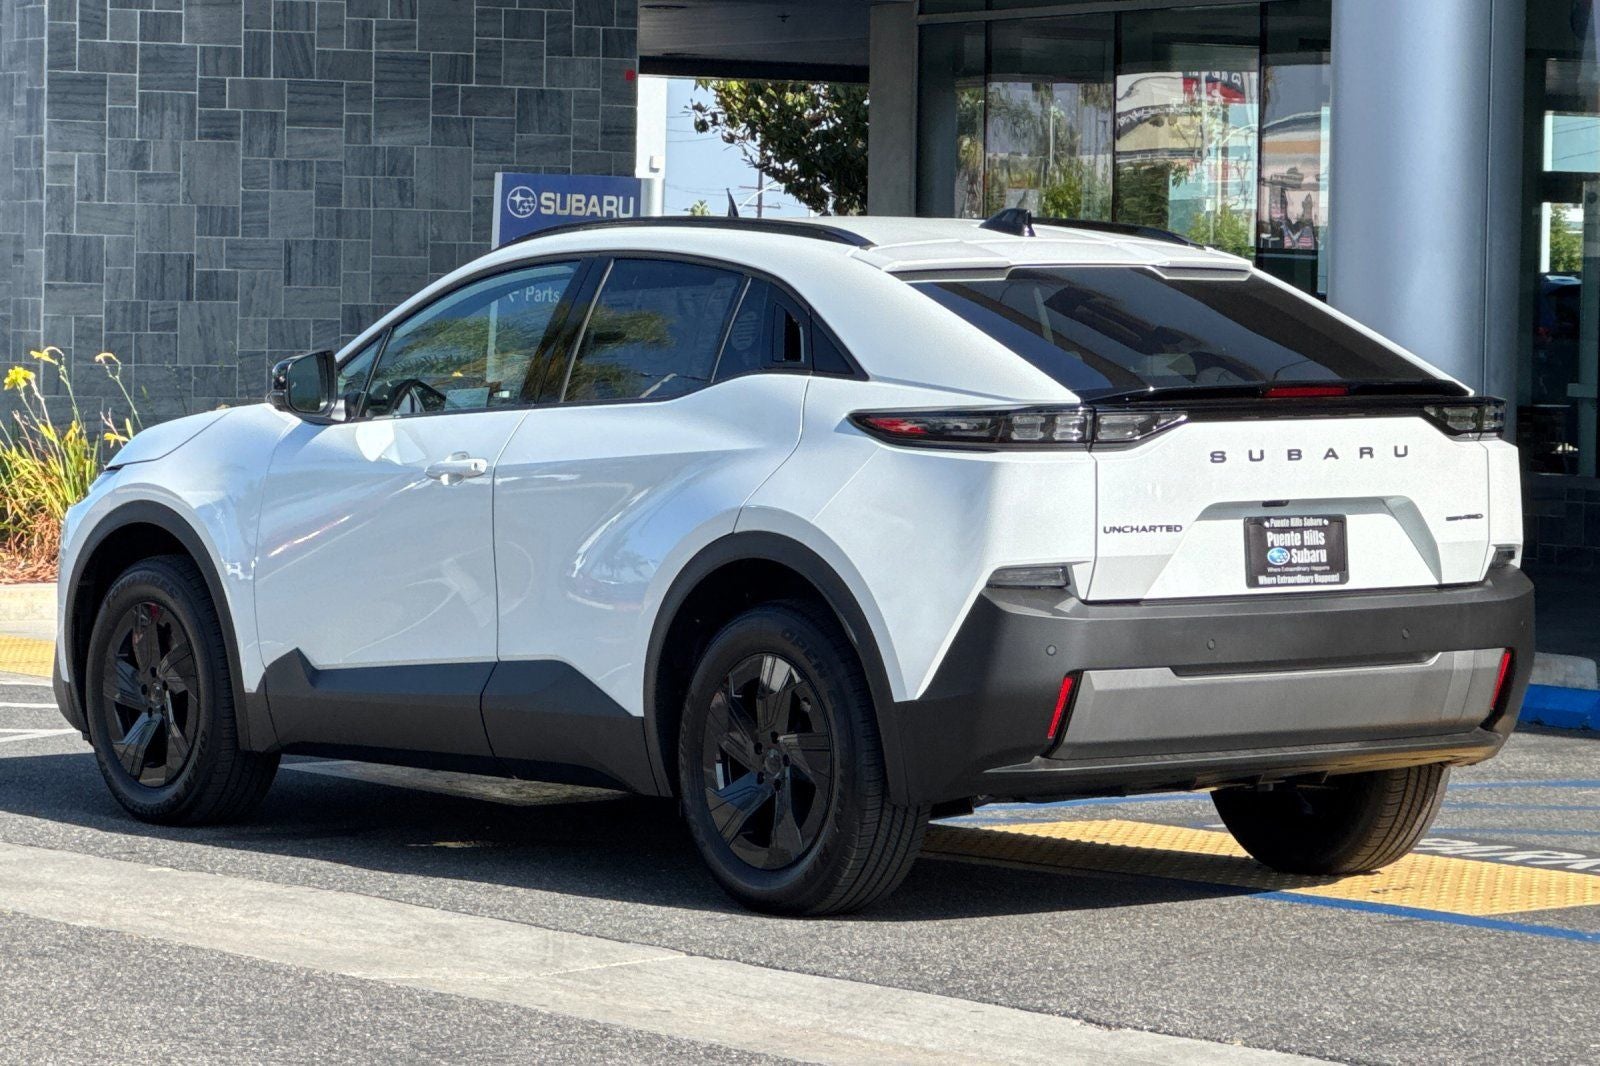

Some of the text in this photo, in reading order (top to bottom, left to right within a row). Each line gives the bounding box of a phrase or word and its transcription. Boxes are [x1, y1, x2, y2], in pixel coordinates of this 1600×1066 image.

[540, 191, 634, 218] SUBARU
[525, 285, 560, 303] Parts
[1209, 445, 1409, 464] SUBARU
[1103, 524, 1183, 534] UNCHARTED
[1266, 529, 1326, 547] Puente Hills
[1291, 548, 1327, 564] Subaru
